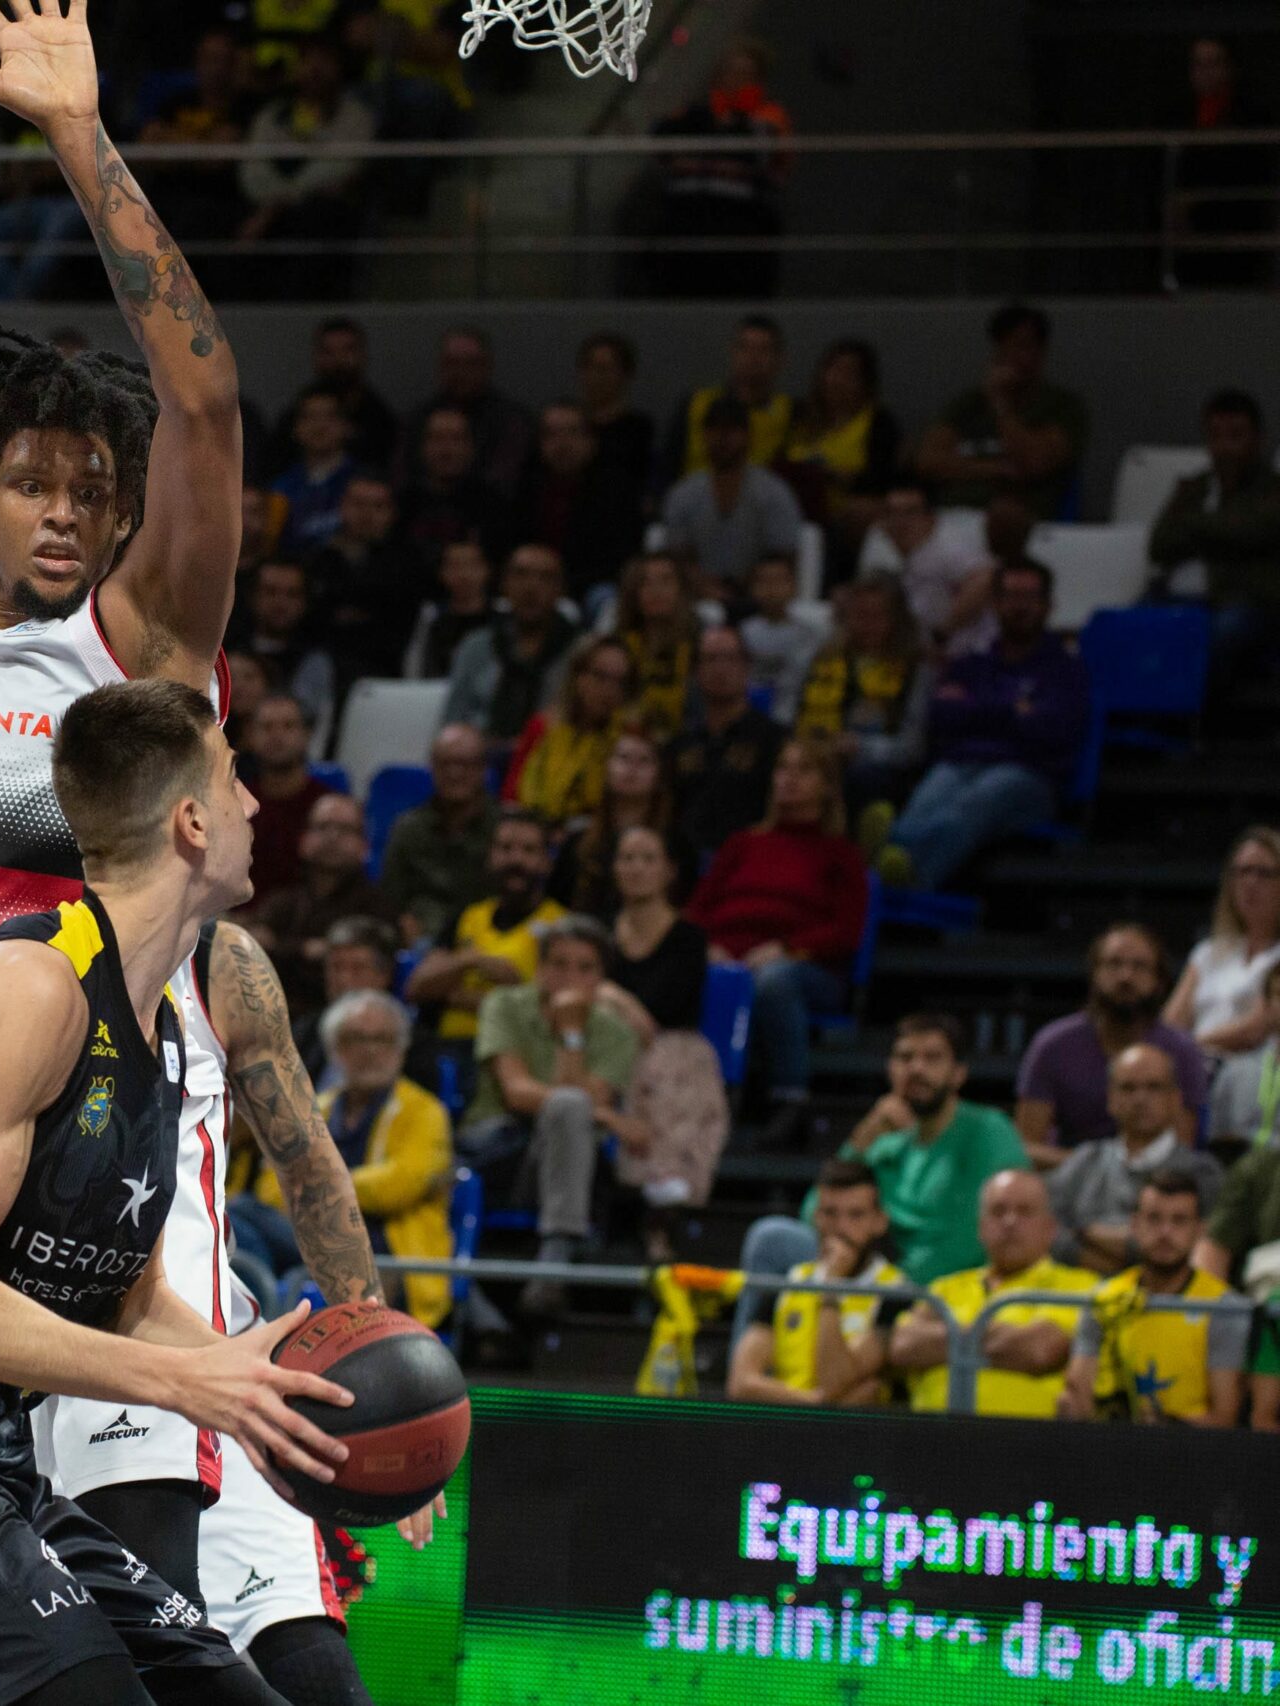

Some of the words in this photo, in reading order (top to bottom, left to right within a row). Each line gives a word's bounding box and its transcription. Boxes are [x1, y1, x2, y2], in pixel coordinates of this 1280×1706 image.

[89, 1427, 150, 1445] MERCURY
[739, 1482, 1203, 1590] Equipamiento
[1209, 1535, 1258, 1612] y
[31, 1590, 72, 1619] LA
[643, 1588, 989, 1671] suministro
[1001, 1601, 1082, 1681] de
